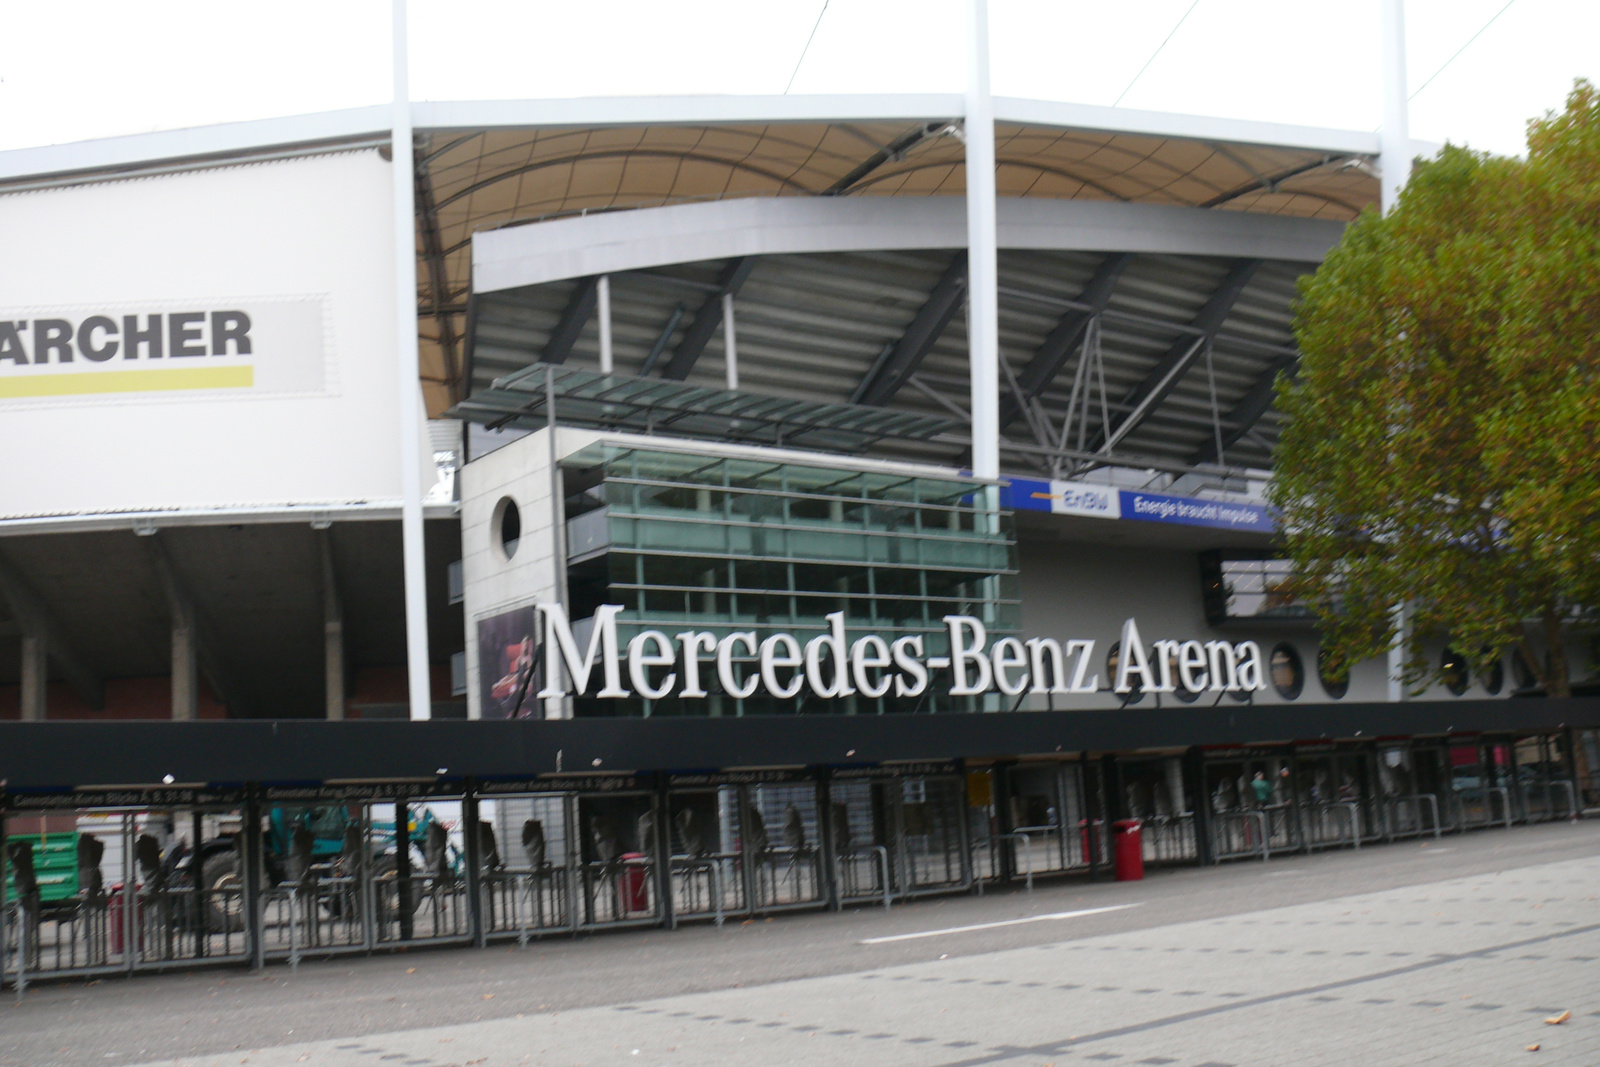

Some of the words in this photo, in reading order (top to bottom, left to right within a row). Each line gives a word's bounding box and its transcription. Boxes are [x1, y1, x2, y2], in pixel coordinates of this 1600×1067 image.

[1063, 489, 1110, 512] EnBW
[1133, 495, 1177, 519] Energie
[1177, 500, 1217, 521] braucht
[1218, 504, 1259, 525] Impulse
[536, 602, 1099, 701] Mercedes-Benz
[1114, 617, 1268, 695] Arena
